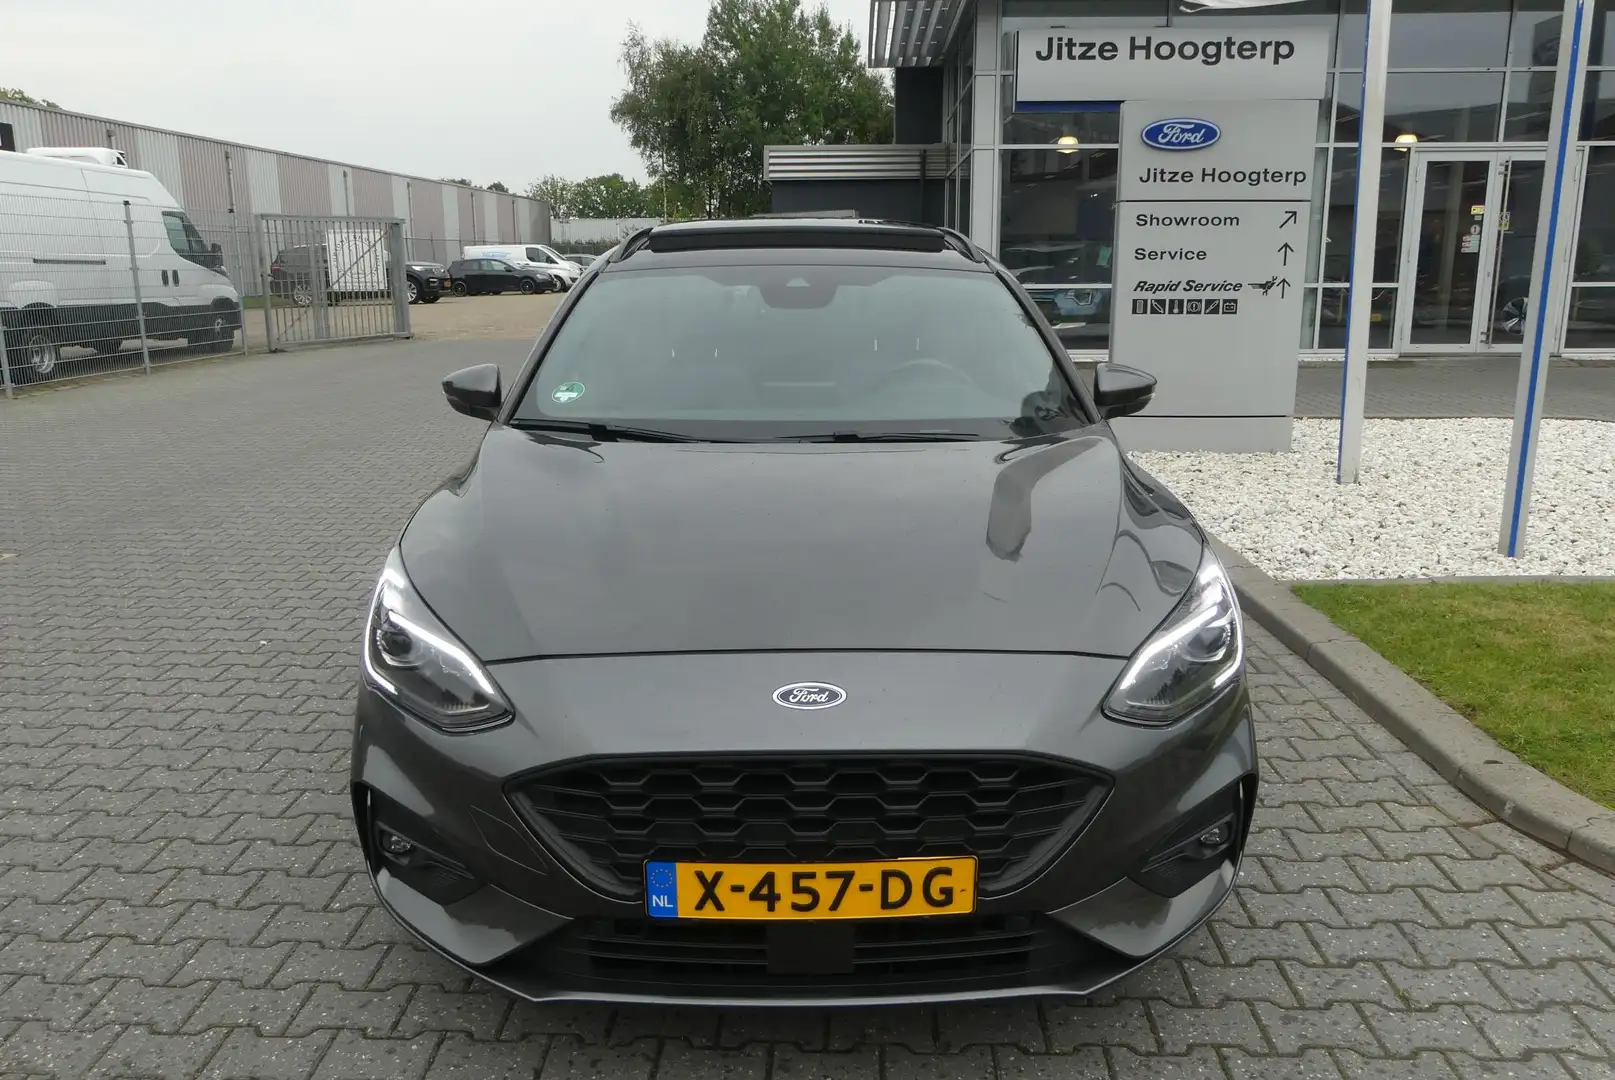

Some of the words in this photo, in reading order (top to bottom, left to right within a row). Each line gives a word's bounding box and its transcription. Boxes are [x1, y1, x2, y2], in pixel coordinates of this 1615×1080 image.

[1035, 36, 1119, 62] Jitze
[1128, 35, 1295, 66] Hoogterp
[1157, 122, 1205, 144] Ford
[1138, 167, 1194, 184] Jitze
[1201, 167, 1307, 187] Hoogterp
[1135, 213, 1240, 227] Showroom
[1134, 247, 1207, 261] Service
[1132, 280, 1182, 295] Rapid
[1182, 279, 1243, 292] Service
[788, 687, 829, 704] Ford
[693, 866, 954, 913] X-457-DG
[652, 894, 674, 908] NL
